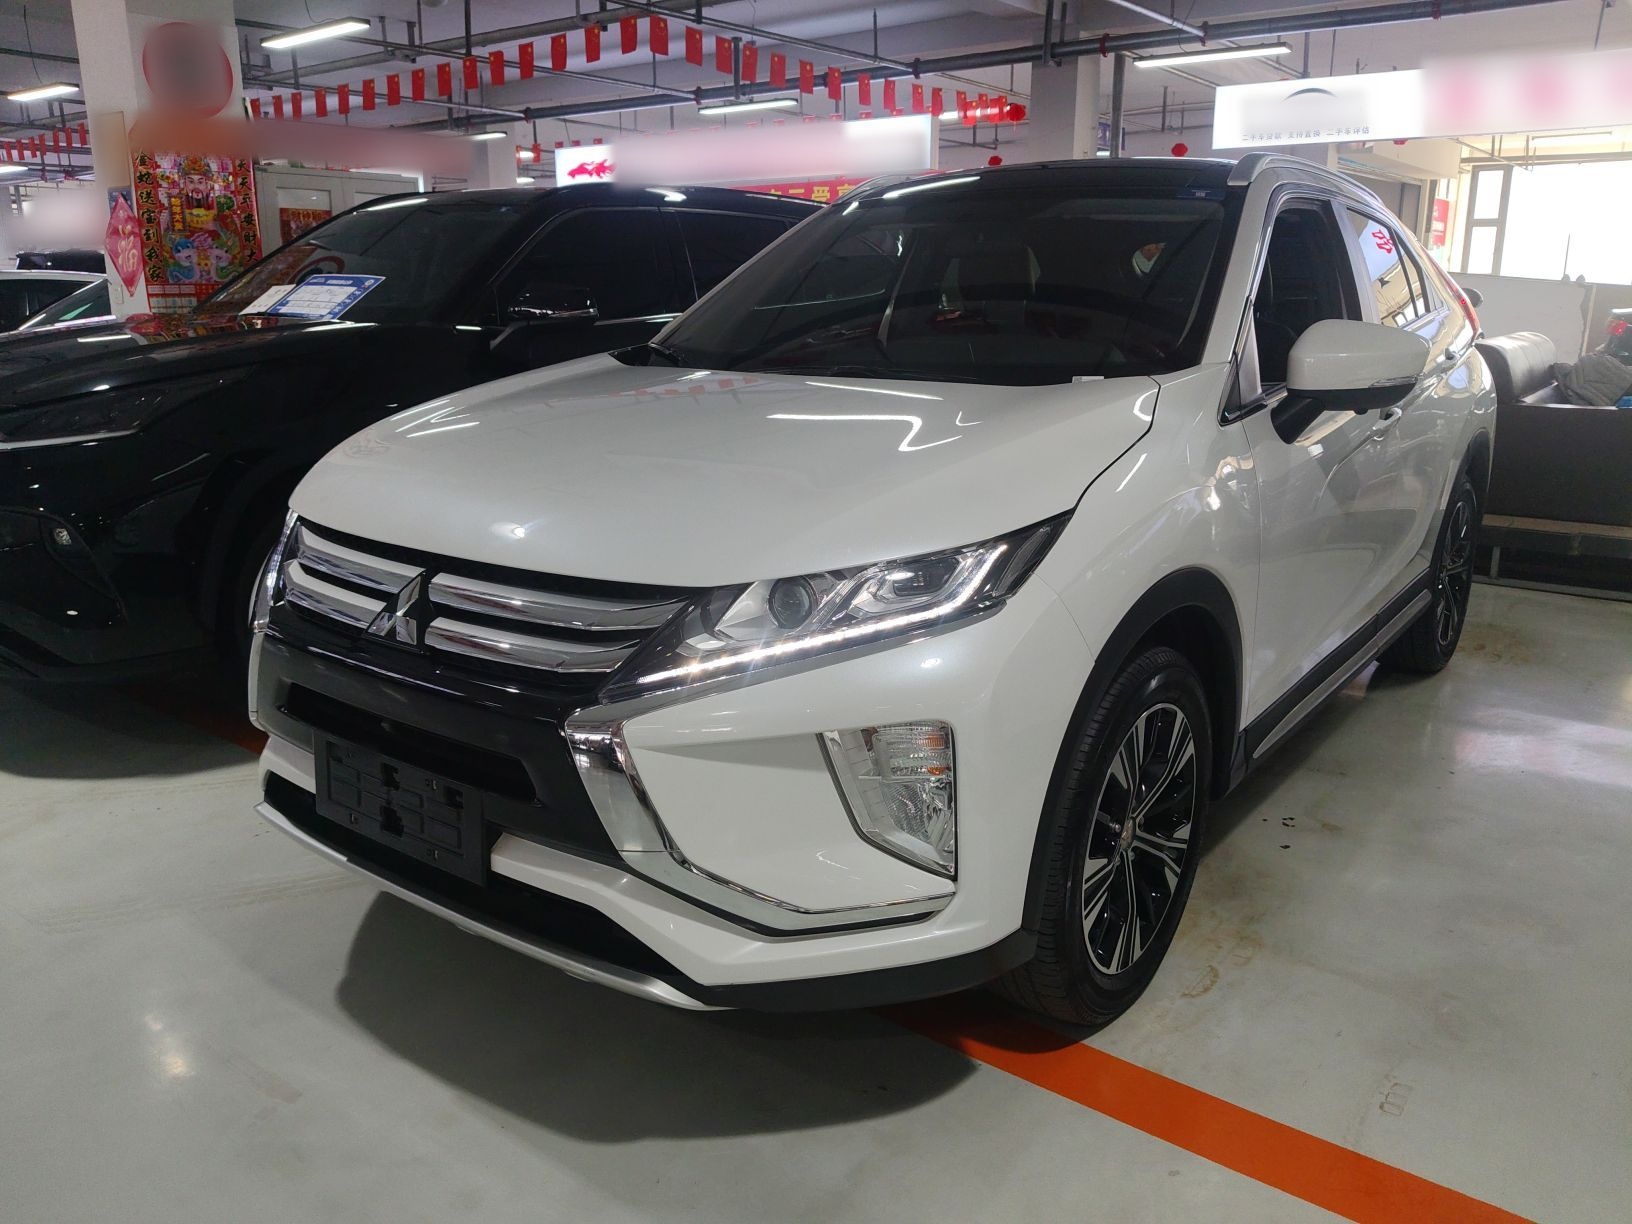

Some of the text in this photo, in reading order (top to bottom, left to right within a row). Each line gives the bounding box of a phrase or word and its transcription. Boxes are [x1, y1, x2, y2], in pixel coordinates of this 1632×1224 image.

[1326, 126, 1370, 137] 二手车评估
